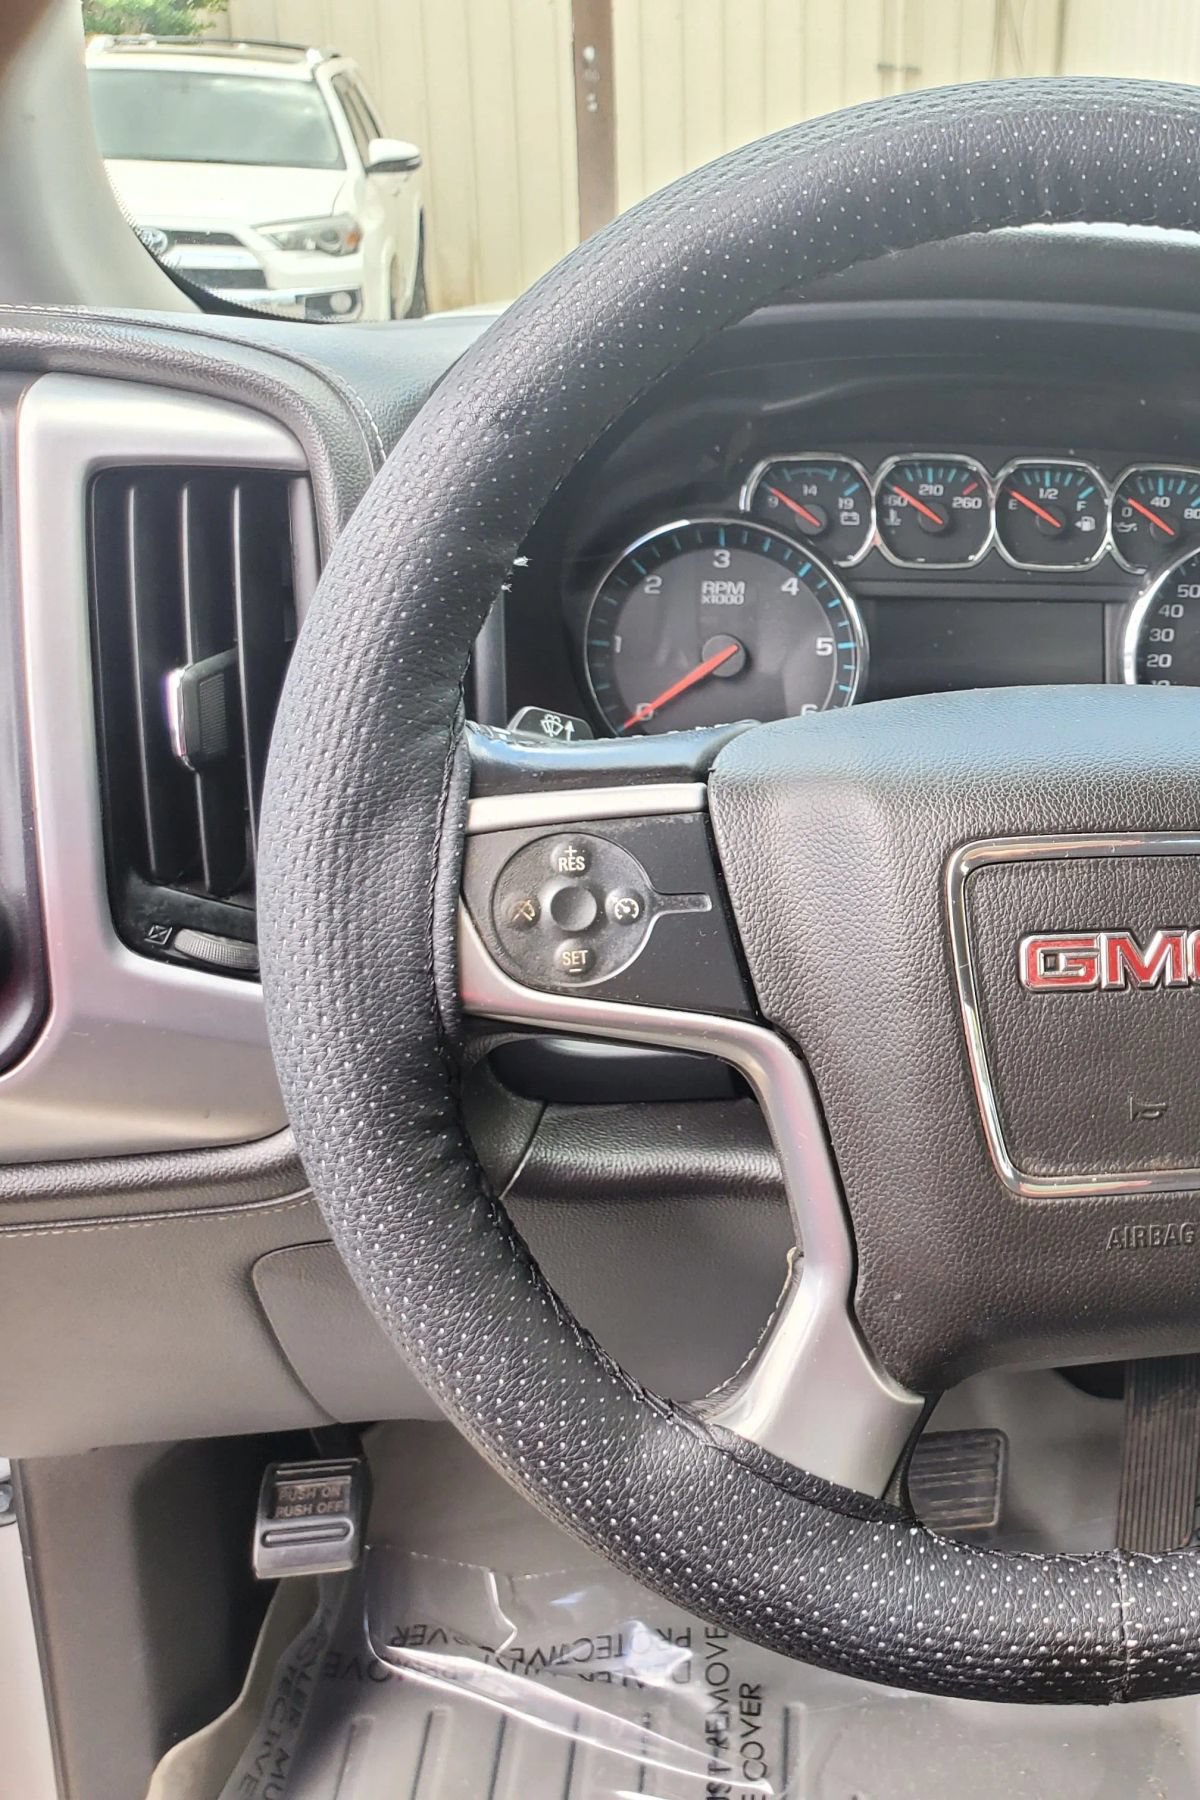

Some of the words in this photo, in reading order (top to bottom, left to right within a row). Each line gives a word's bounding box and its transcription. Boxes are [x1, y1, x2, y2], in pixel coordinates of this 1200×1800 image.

[802, 484, 818, 497] 14
[918, 483, 944, 497] 210
[1038, 487, 1059, 500] 1/2
[768, 497, 779, 508] 9
[838, 497, 854, 510] 19
[952, 497, 982, 510] 260
[1008, 499, 1018, 510] E
[1076, 500, 1087, 512] F
[1150, 496, 1171, 508] 40
[1122, 505, 1133, 517] 0
[712, 551, 731, 568] 3
[644, 576, 662, 594] 2
[701, 581, 745, 595] RPM
[781, 577, 799, 596] 4
[1158, 604, 1184, 618] 40
[1150, 628, 1174, 642] 30
[614, 635, 622, 653] 1
[815, 638, 834, 656] 5
[1147, 653, 1172, 668] 20
[635, 703, 655, 721] 0
[558, 857, 585, 872] RES
[562, 950, 588, 966] SET
[1106, 1222, 1196, 1250] AIRBAG
[278, 1484, 317, 1501] PUSH
[321, 1484, 342, 1498] ON
[275, 1502, 313, 1518] PUSH
[316, 1500, 344, 1515] OFF
[739, 1682, 768, 1782] COVER
